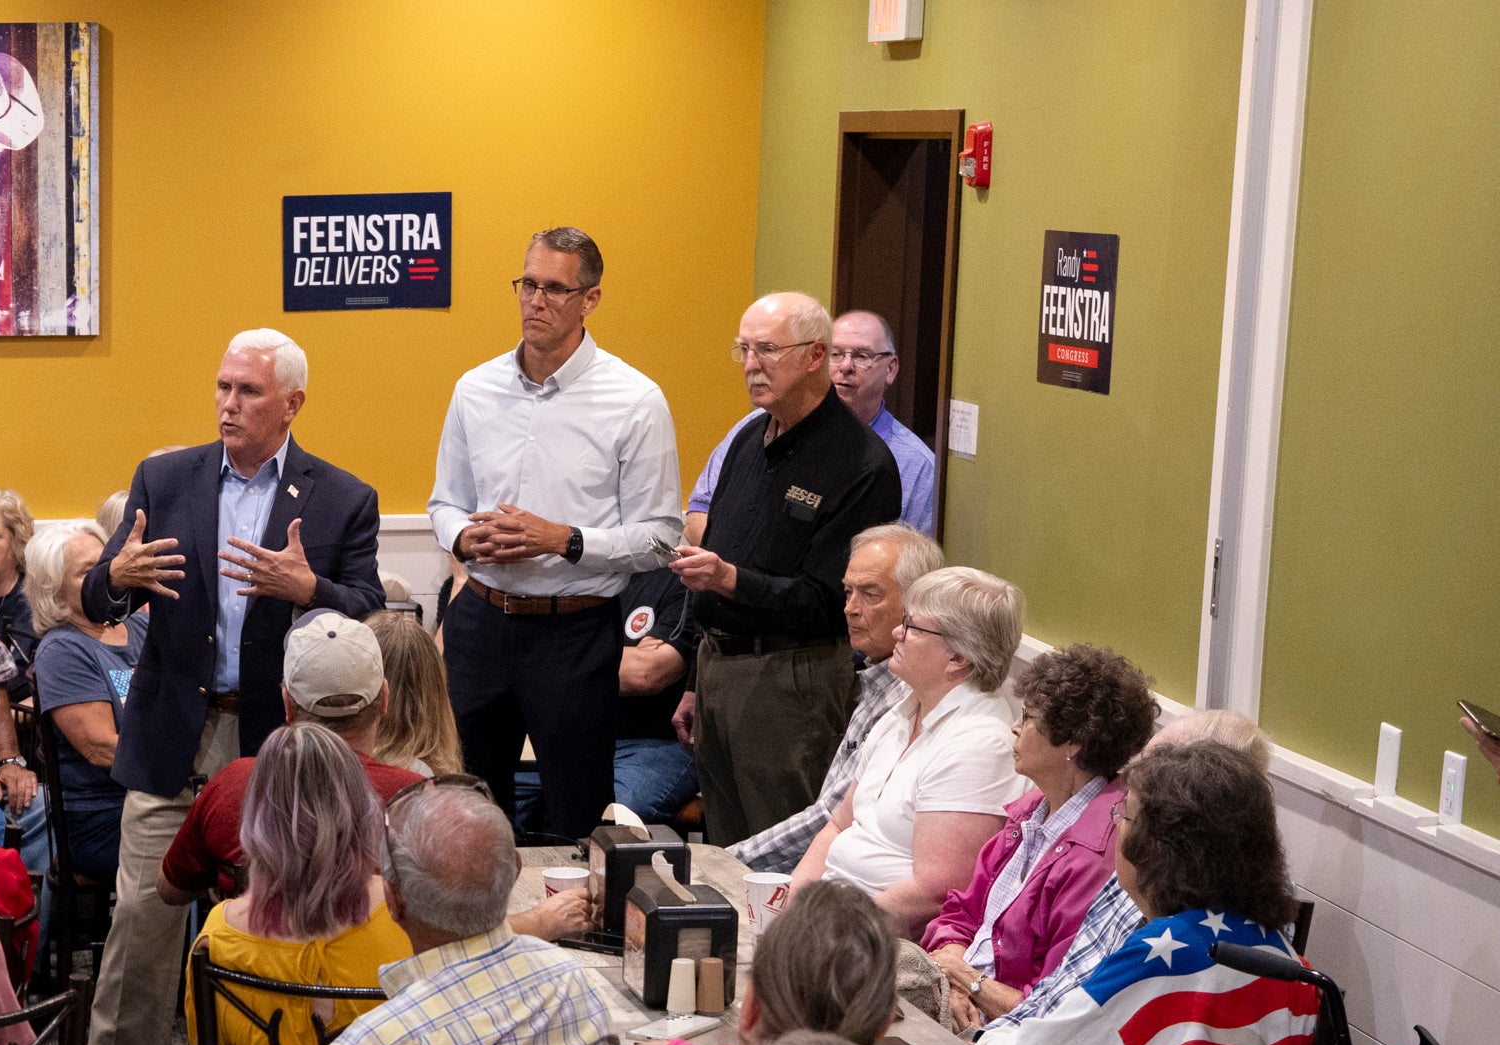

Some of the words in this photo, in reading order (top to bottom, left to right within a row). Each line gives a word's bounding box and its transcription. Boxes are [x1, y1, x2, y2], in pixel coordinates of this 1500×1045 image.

[293, 213, 441, 254] FEENSTRA
[293, 255, 402, 286] DELIVERS
[1056, 247, 1081, 282] Randy
[1042, 284, 1110, 343] FEENSTRA
[1056, 347, 1089, 364] CONGRESS
